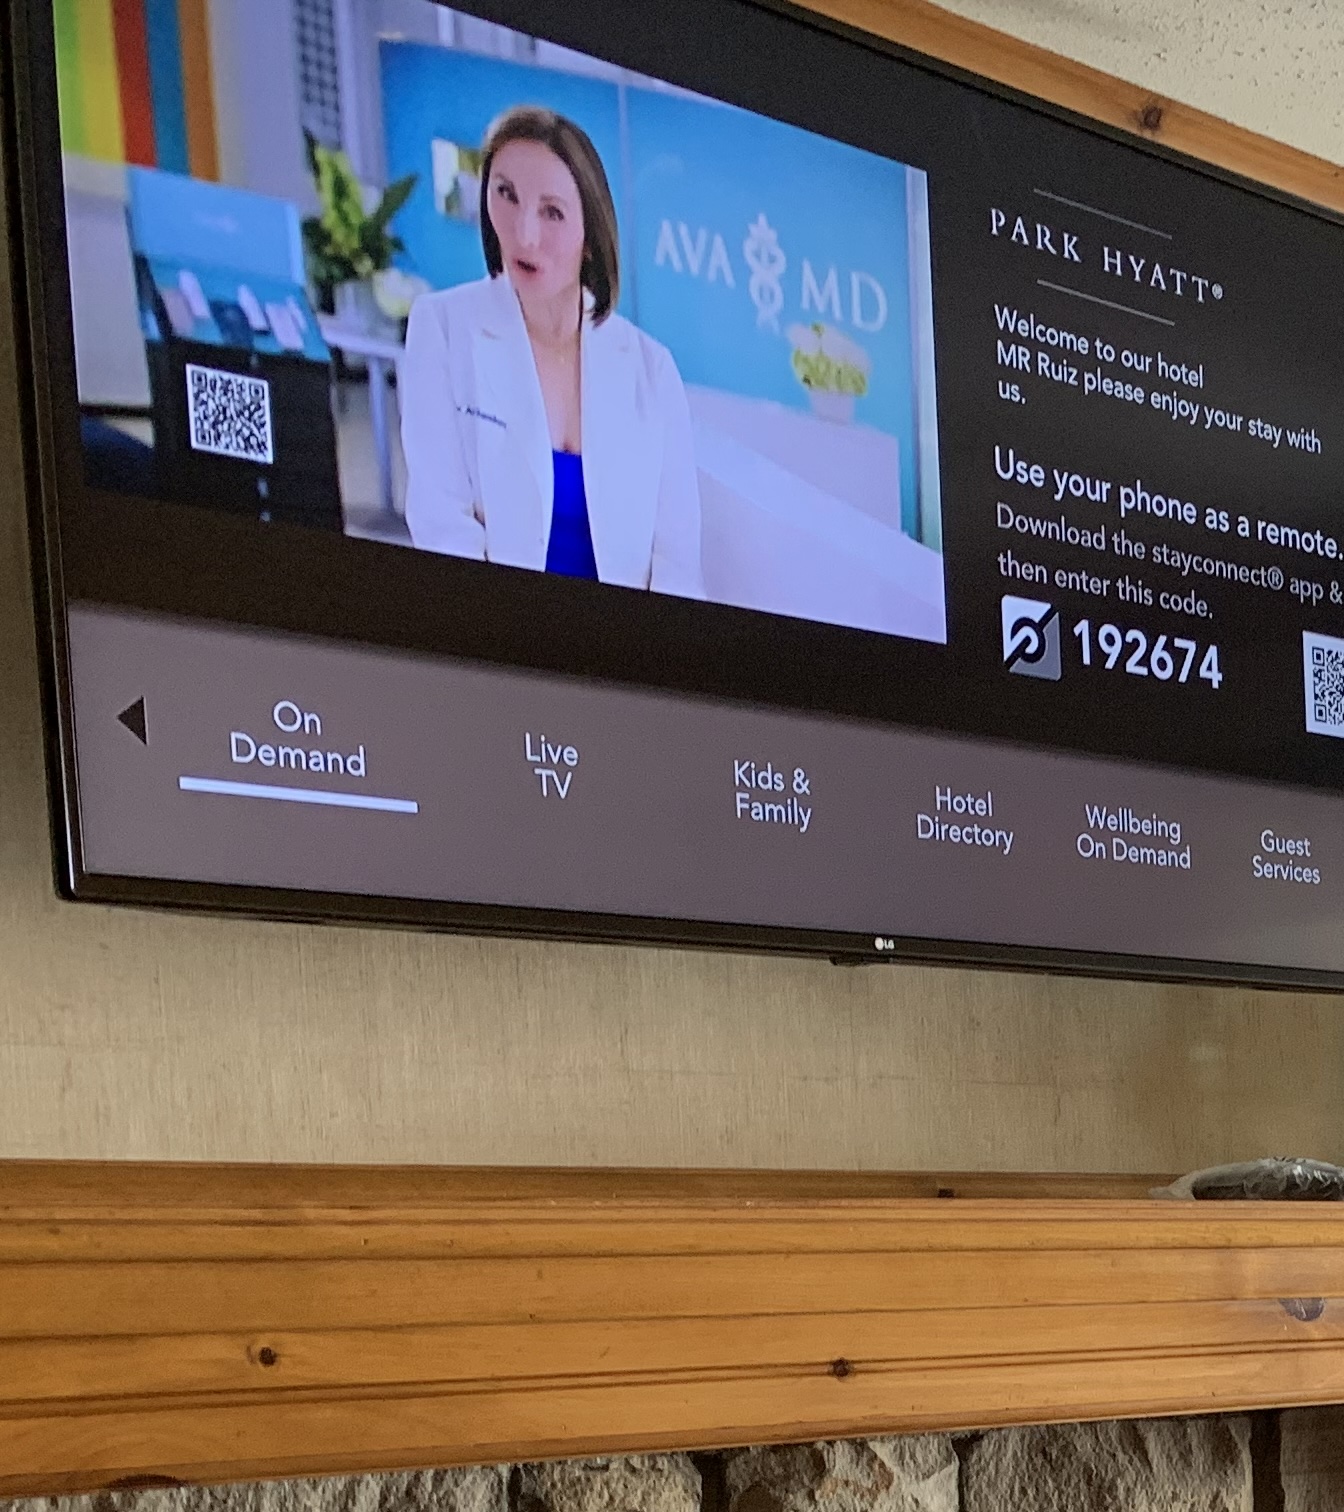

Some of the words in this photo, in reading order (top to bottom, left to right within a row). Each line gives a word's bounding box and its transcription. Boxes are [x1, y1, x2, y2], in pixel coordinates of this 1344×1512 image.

[991, 208, 1081, 262] PARK
[655, 219, 735, 288] AVA
[801, 258, 888, 332] MD
[994, 304, 1089, 354] Welcome
[1095, 337, 1115, 362] to
[1121, 350, 1152, 373] our
[1158, 352, 1203, 388] hotel
[997, 339, 1030, 373] MR
[1038, 351, 1078, 385] Ruiz
[1084, 367, 1144, 404] please
[1151, 391, 1199, 425] enjoy
[1204, 406, 1243, 431] your
[1248, 418, 1282, 448] stay
[1287, 429, 1321, 454] with
[999, 380, 1025, 404] us.
[995, 445, 1045, 487] Use
[1053, 469, 1111, 503] your
[1120, 479, 1196, 524] phone
[1205, 508, 1229, 532] as
[1237, 516, 1249, 537] a
[1258, 520, 1343, 560] remote.
[997, 502, 1105, 550] Download
[1112, 529, 1145, 559] the
[1290, 577, 1324, 606] app
[1330, 581, 1342, 604] &
[998, 550, 1047, 584] then
[1055, 569, 1110, 596] enter
[1116, 575, 1153, 606] this
[1160, 589, 1212, 619] code.
[1074, 619, 1222, 689] 192674
[274, 701, 321, 735] On
[231, 732, 365, 777] Demand
[526, 732, 578, 766] Live
[535, 768, 572, 799] TV
[734, 760, 784, 791] Kids
[793, 768, 810, 795] &
[736, 792, 811, 832] Family
[936, 786, 992, 816] Hotel
[918, 814, 1013, 855] Directory
[1086, 804, 1180, 845] Wellbeing
[1261, 830, 1310, 857] Guest
[1077, 833, 1106, 859] On
[1113, 838, 1190, 869] Demand
[1253, 855, 1320, 884] Services
